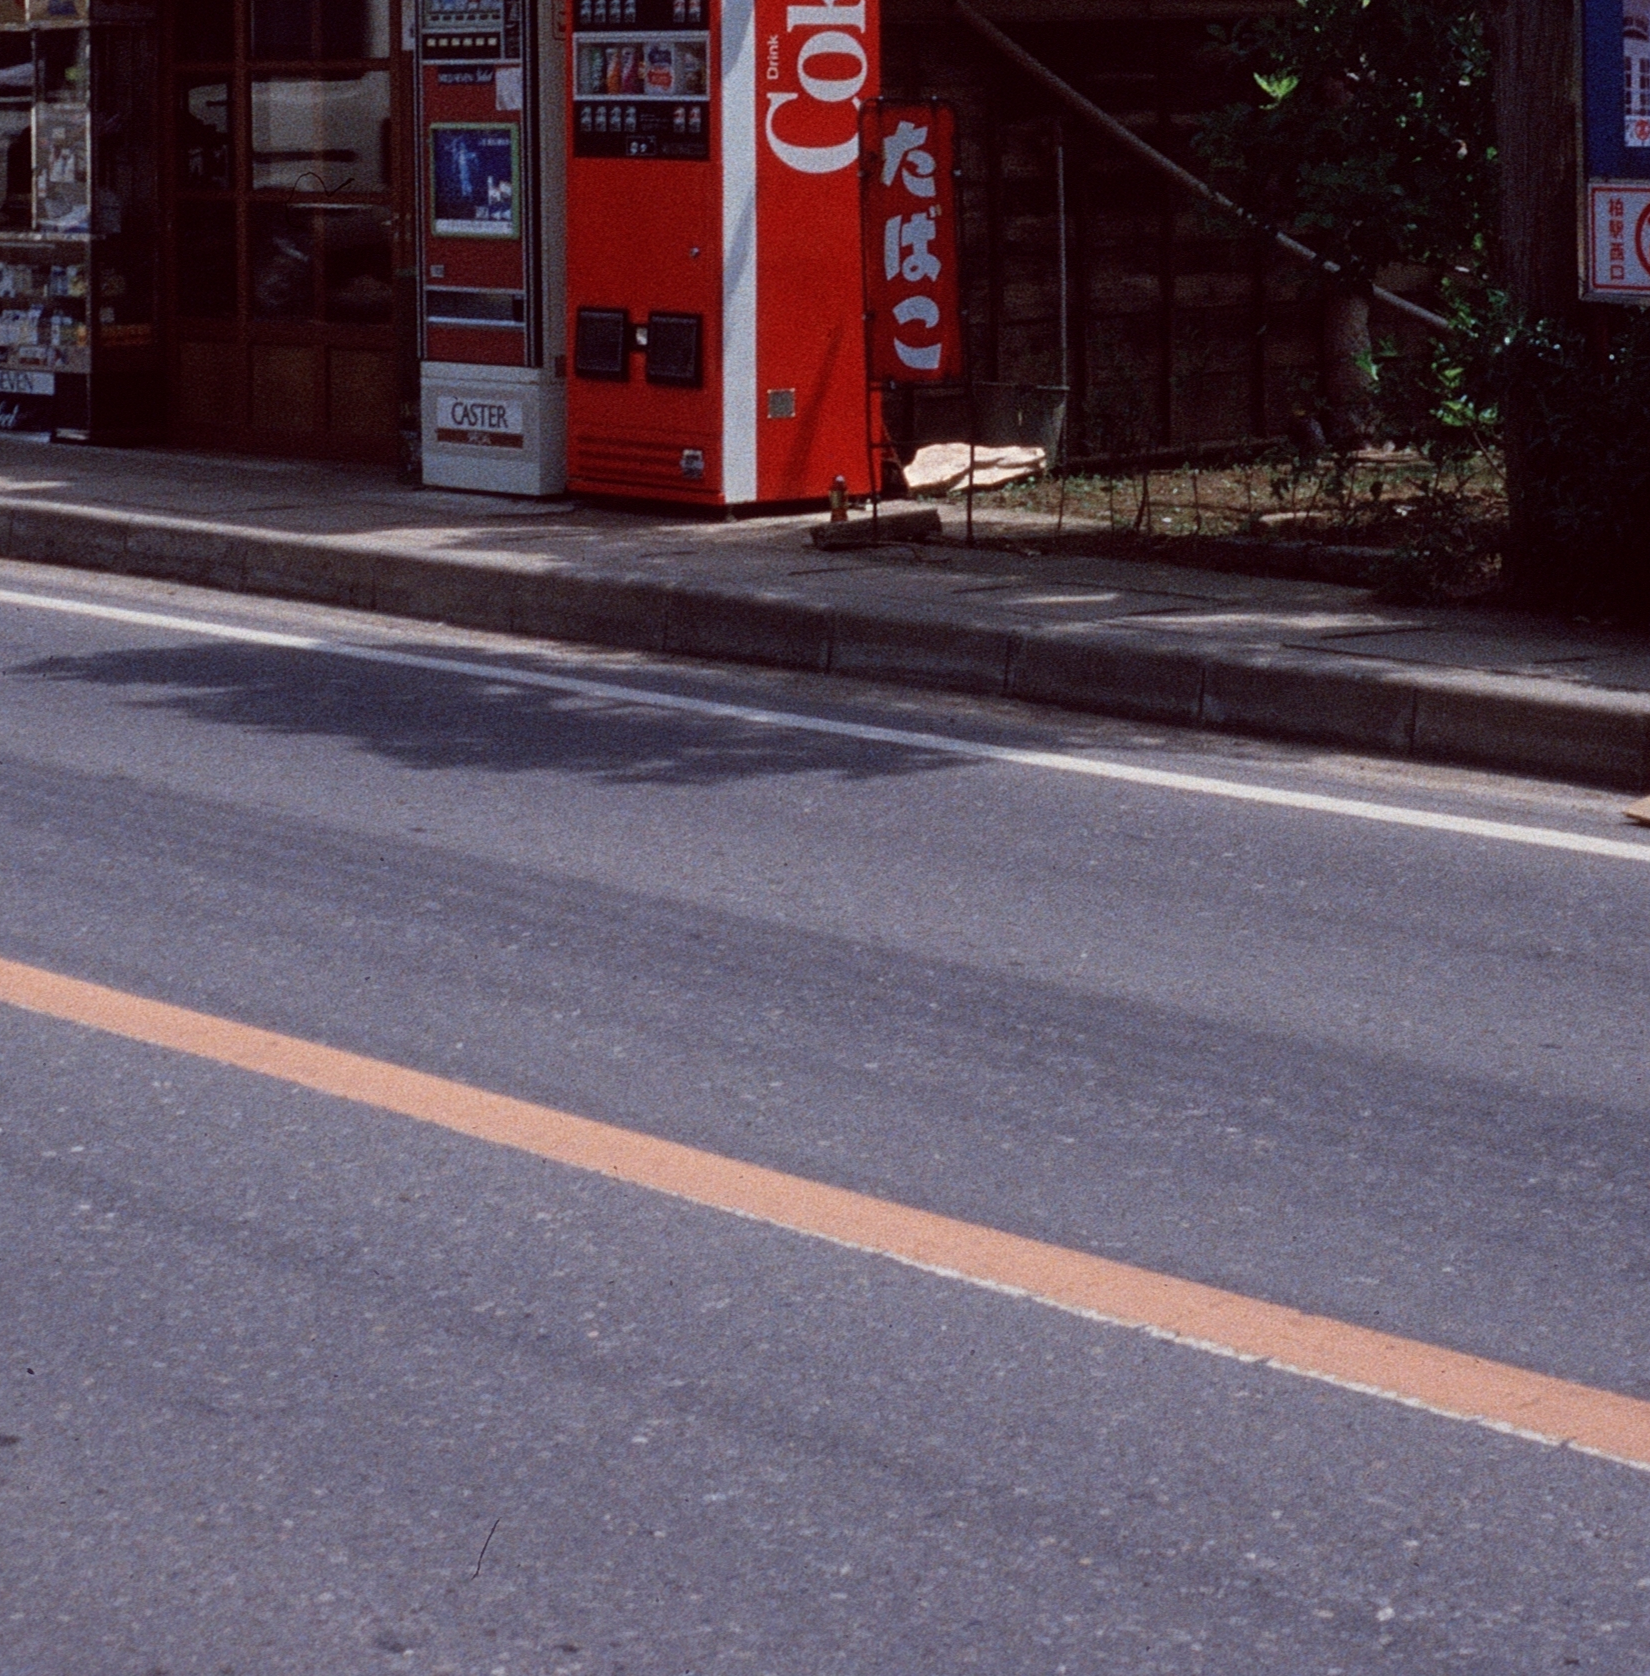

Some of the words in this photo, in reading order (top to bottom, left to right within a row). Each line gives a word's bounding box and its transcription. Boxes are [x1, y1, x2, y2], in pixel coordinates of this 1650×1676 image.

[766, 34, 779, 81] Drink
[880, 120, 943, 370] たばこ
[451, 401, 509, 429] CASTER
